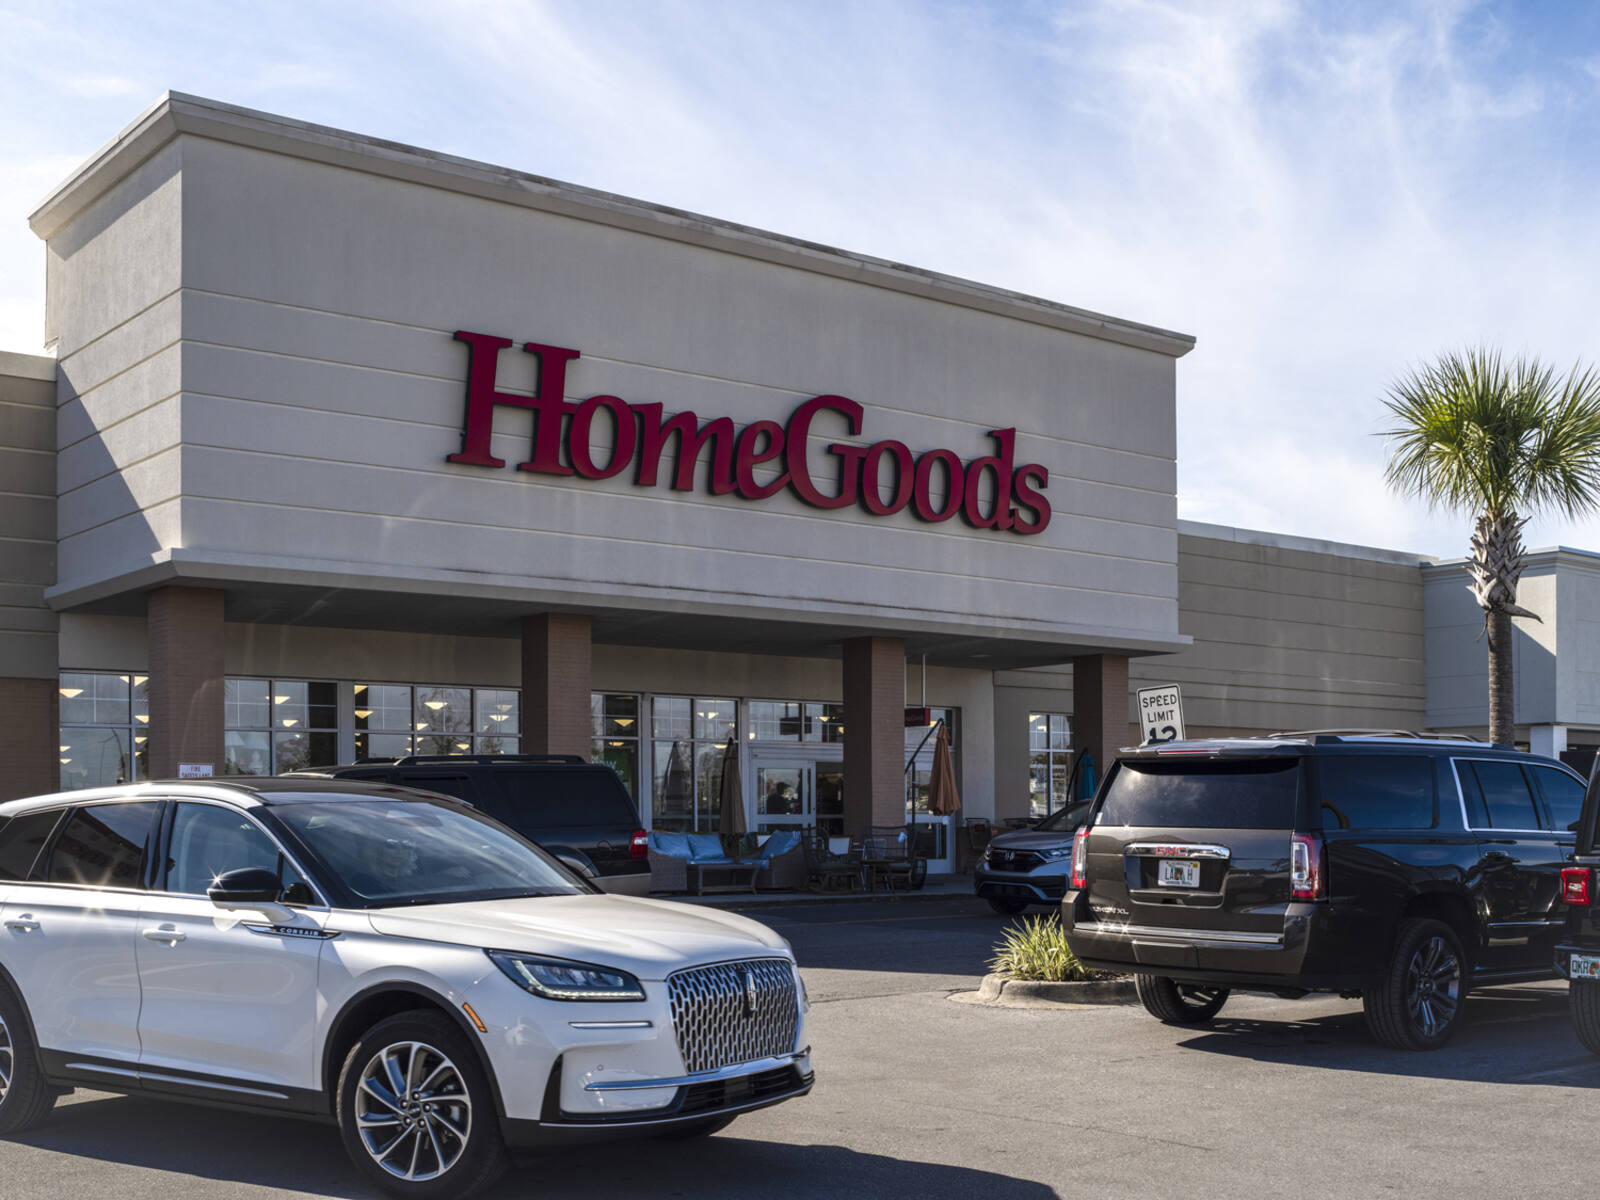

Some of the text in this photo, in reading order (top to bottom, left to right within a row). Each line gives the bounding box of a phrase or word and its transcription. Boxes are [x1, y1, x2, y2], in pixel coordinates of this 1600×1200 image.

[446, 330, 1052, 535] HomeGoods
[1142, 694, 1177, 708] SPEED
[1147, 709, 1174, 723] LIMIT
[1154, 846, 1187, 857] GMC
[280, 927, 320, 937] CORSAIR
